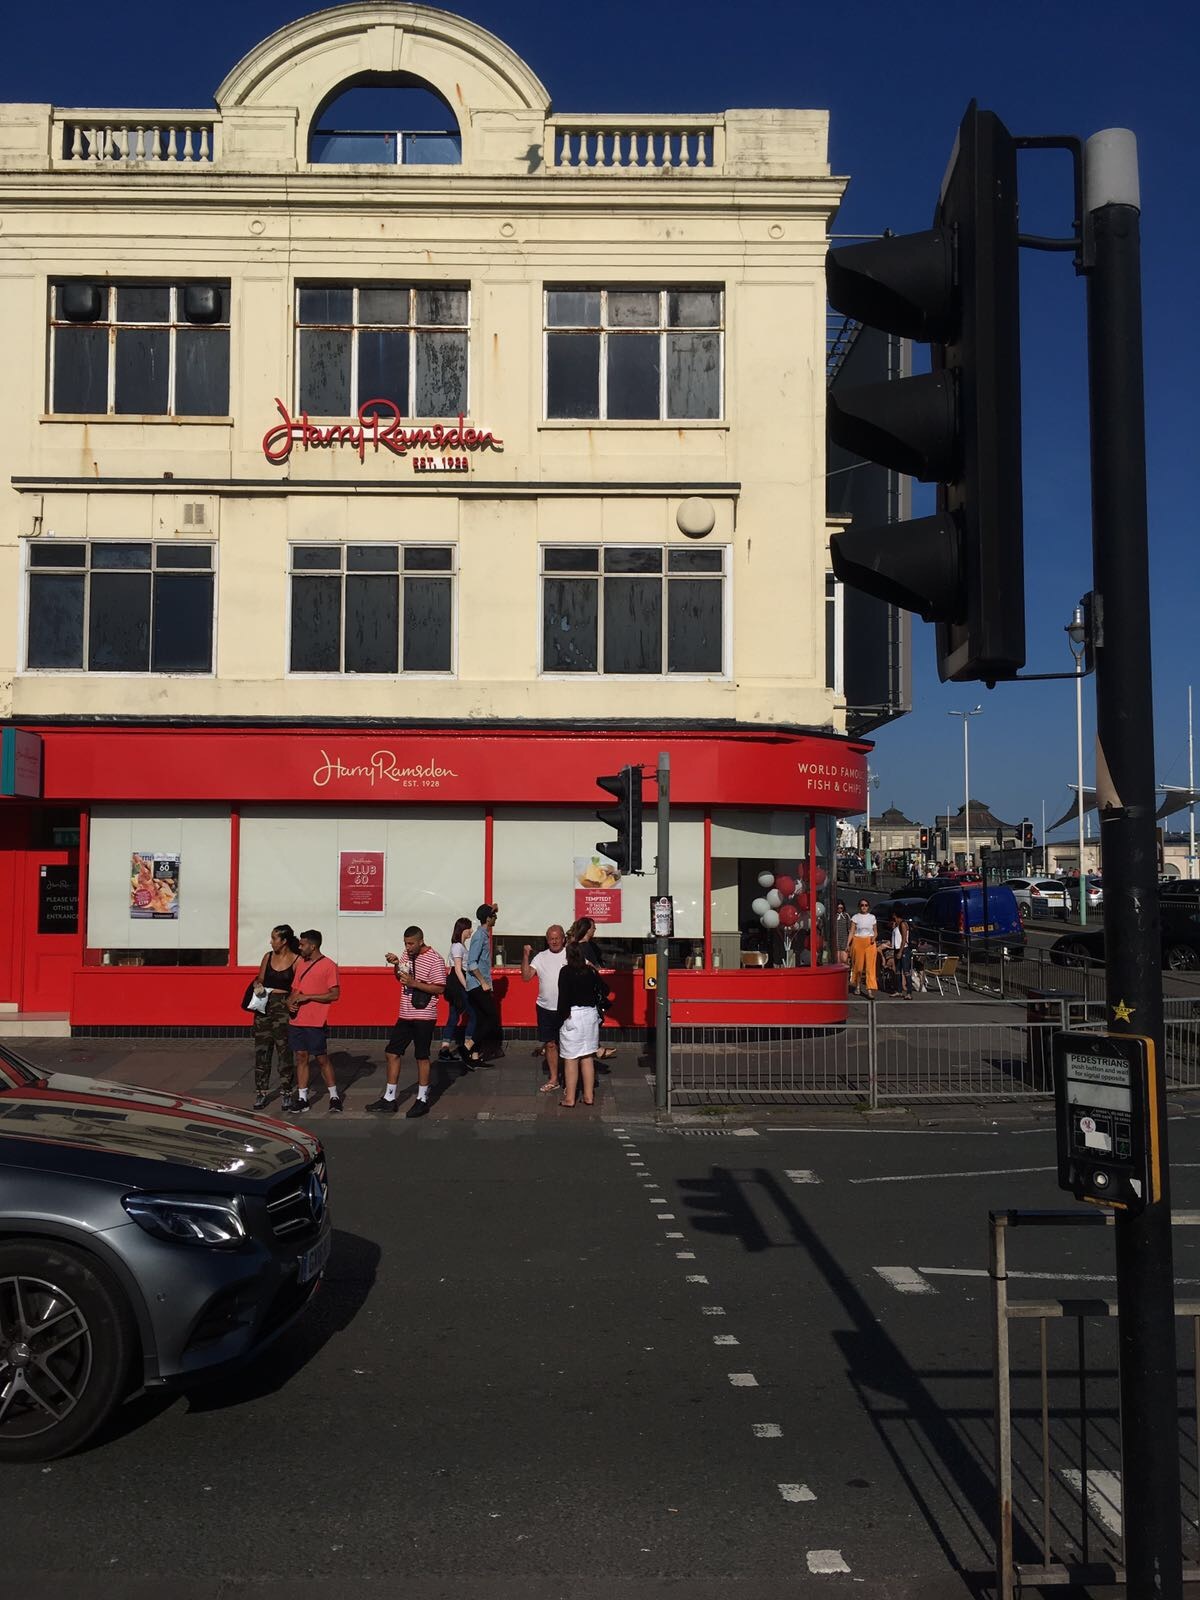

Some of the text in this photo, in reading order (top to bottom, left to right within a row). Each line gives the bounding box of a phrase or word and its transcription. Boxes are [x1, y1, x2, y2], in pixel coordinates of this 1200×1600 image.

[262, 397, 504, 462] Harry Ramsden
[313, 749, 459, 787] Harry Ramsden
[797, 762, 838, 776] WORLD
[402, 780, 440, 788] EST. 1928
[807, 779, 831, 791] FISH
[834, 782, 840, 792] &
[347, 865, 377, 874] CLUB
[1071, 1054, 1129, 1069] PEDESTRIANS
[1084, 1071, 1100, 1079] signal
[1101, 1073, 1126, 1081] opposite
